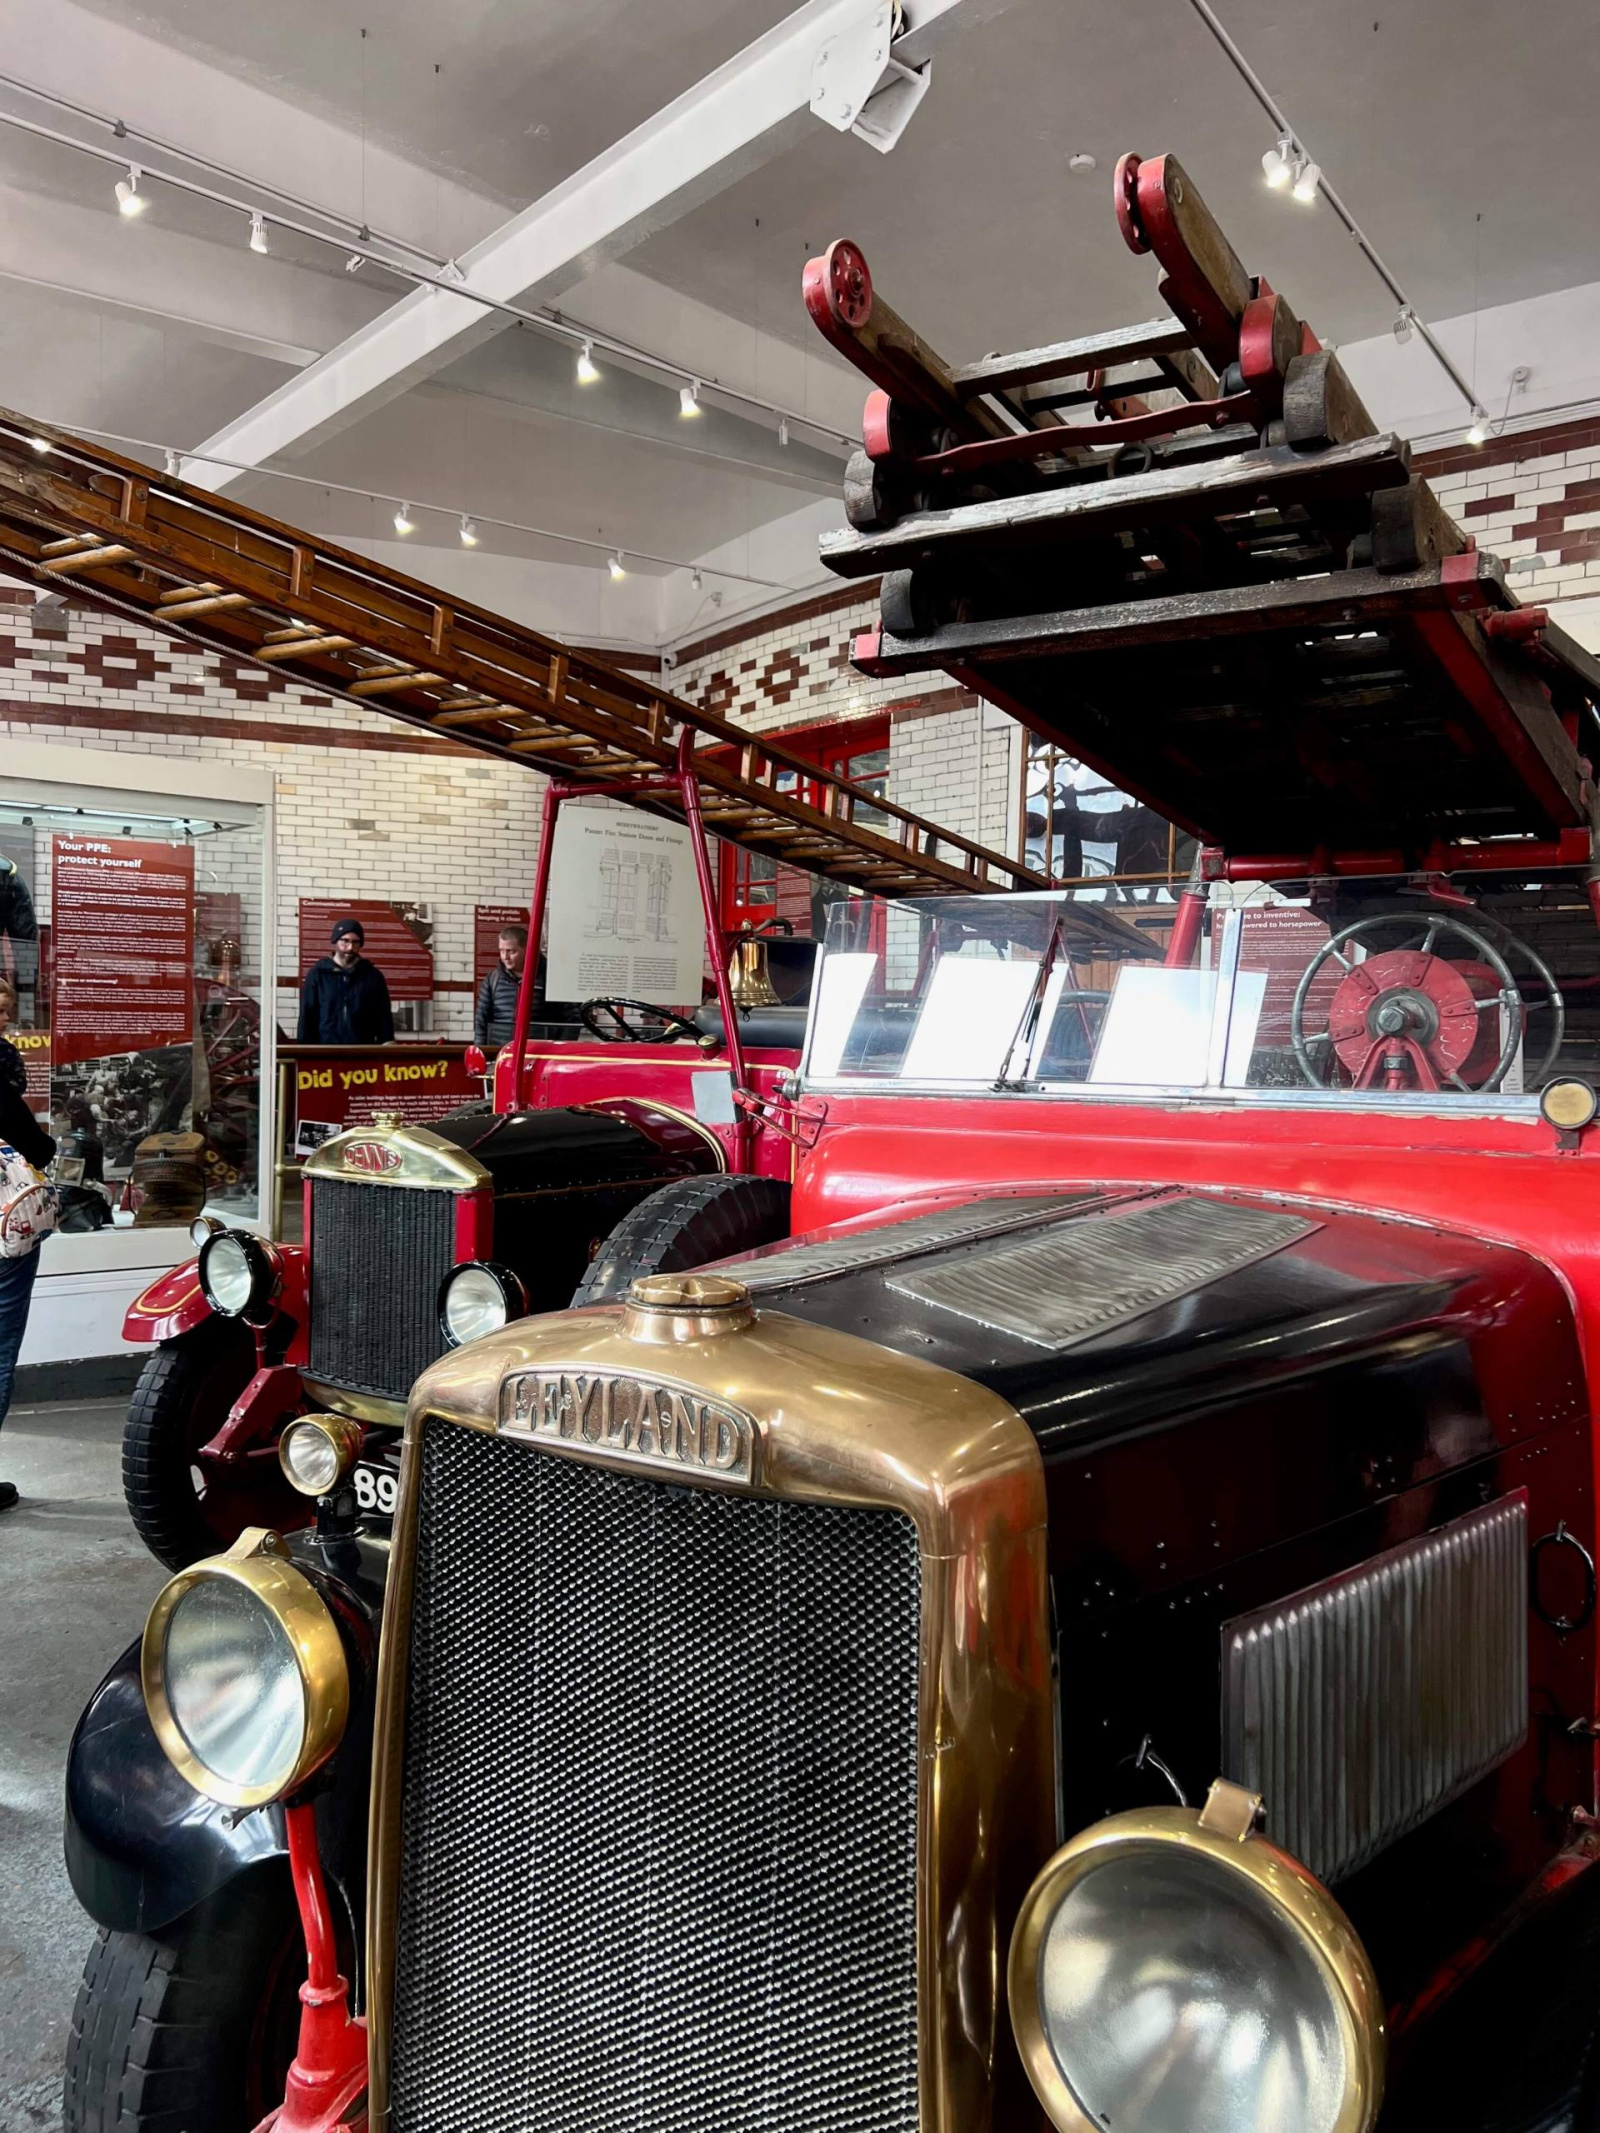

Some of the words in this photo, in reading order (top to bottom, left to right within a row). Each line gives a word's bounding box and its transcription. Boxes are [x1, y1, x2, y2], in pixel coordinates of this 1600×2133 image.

[58, 840, 84, 851] Your
[85, 842, 111, 854] PPE:
[58, 855, 98, 866] protect
[100, 858, 142, 868] yourself
[302, 900, 352, 908] Communication
[1253, 912, 1262, 920] to
[1264, 911, 1301, 919] inventive:
[1279, 920, 1322, 930] horsepower
[298, 1069, 333, 1090] Did
[340, 1068, 378, 1090] you
[384, 1060, 448, 1082] know?
[346, 1144, 398, 1172] DENNIS
[502, 1374, 739, 1470] LEYLAND
